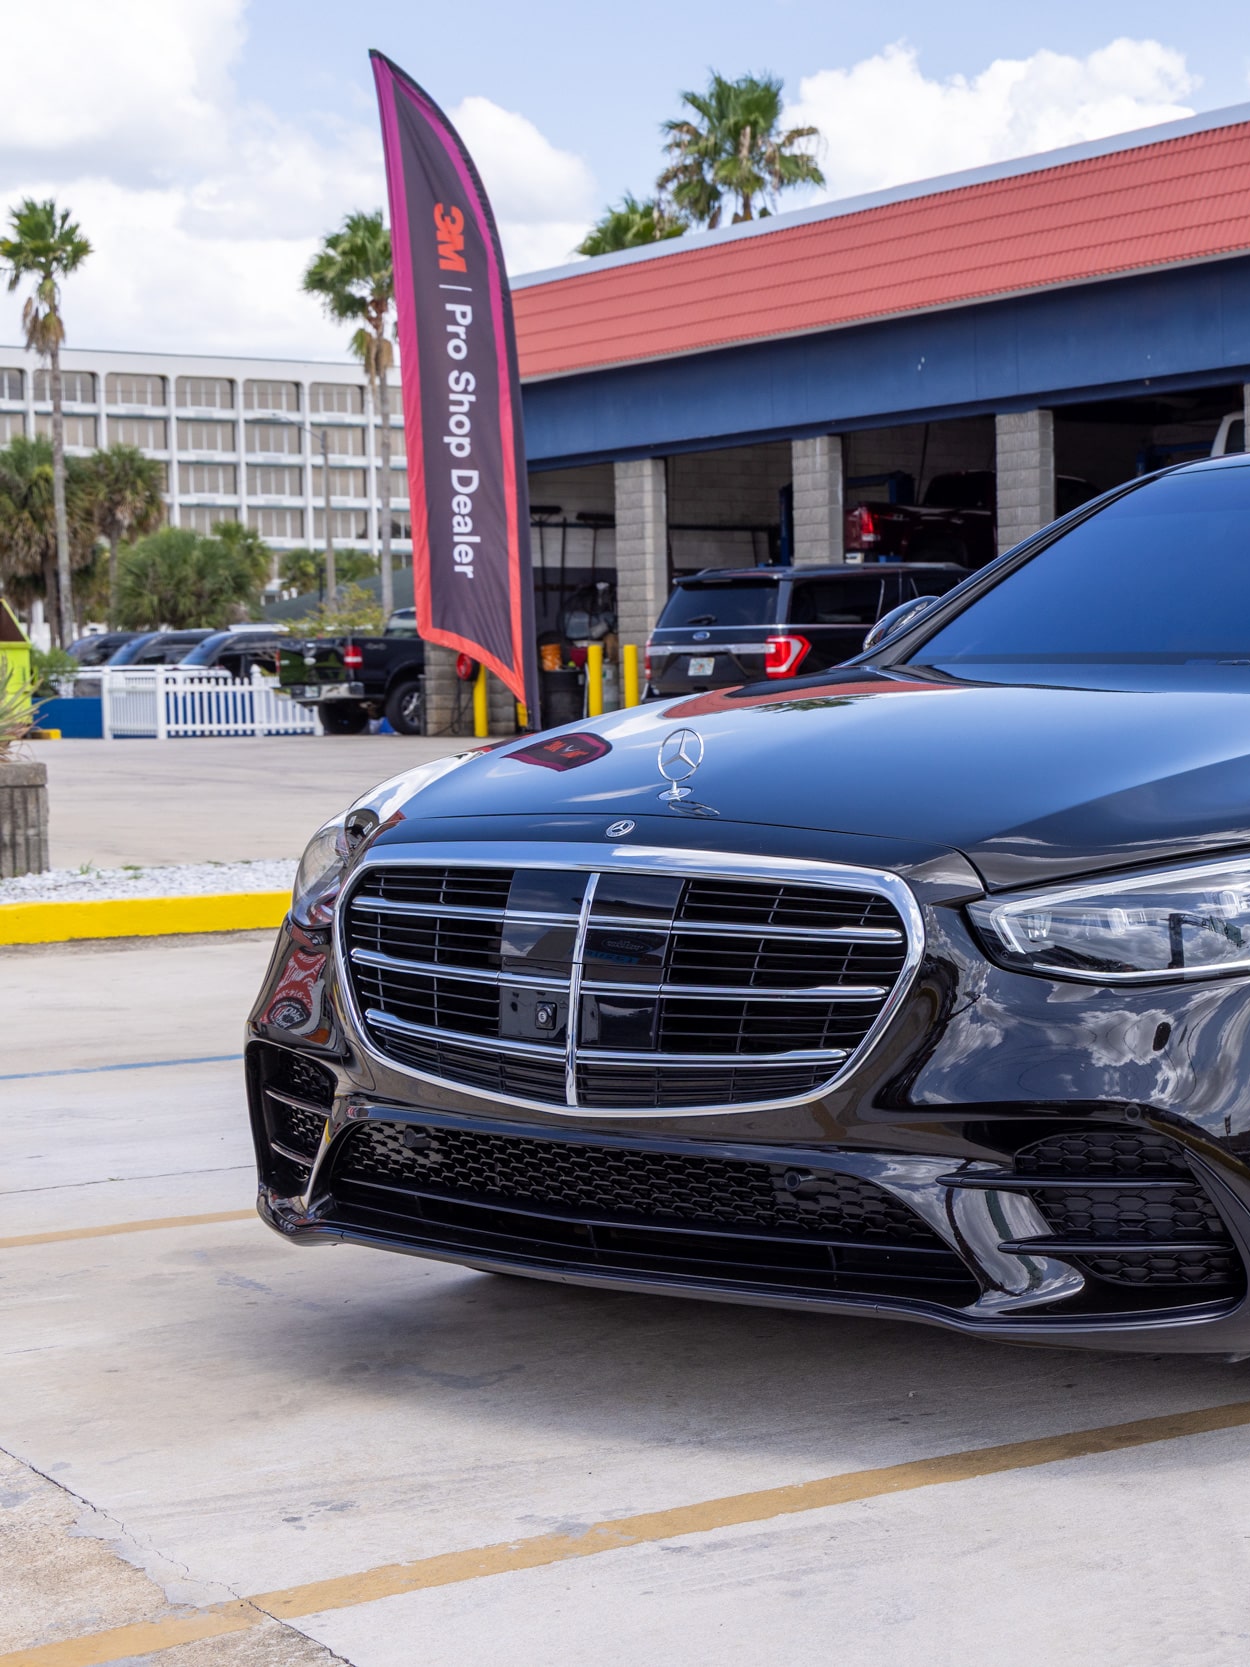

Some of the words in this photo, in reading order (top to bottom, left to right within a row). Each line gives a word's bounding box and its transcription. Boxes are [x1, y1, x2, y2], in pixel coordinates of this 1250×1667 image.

[433, 202, 468, 274] 3M
[445, 302, 474, 361] Pro
[442, 370, 476, 459] Shop
[450, 468, 482, 580] Dealer
